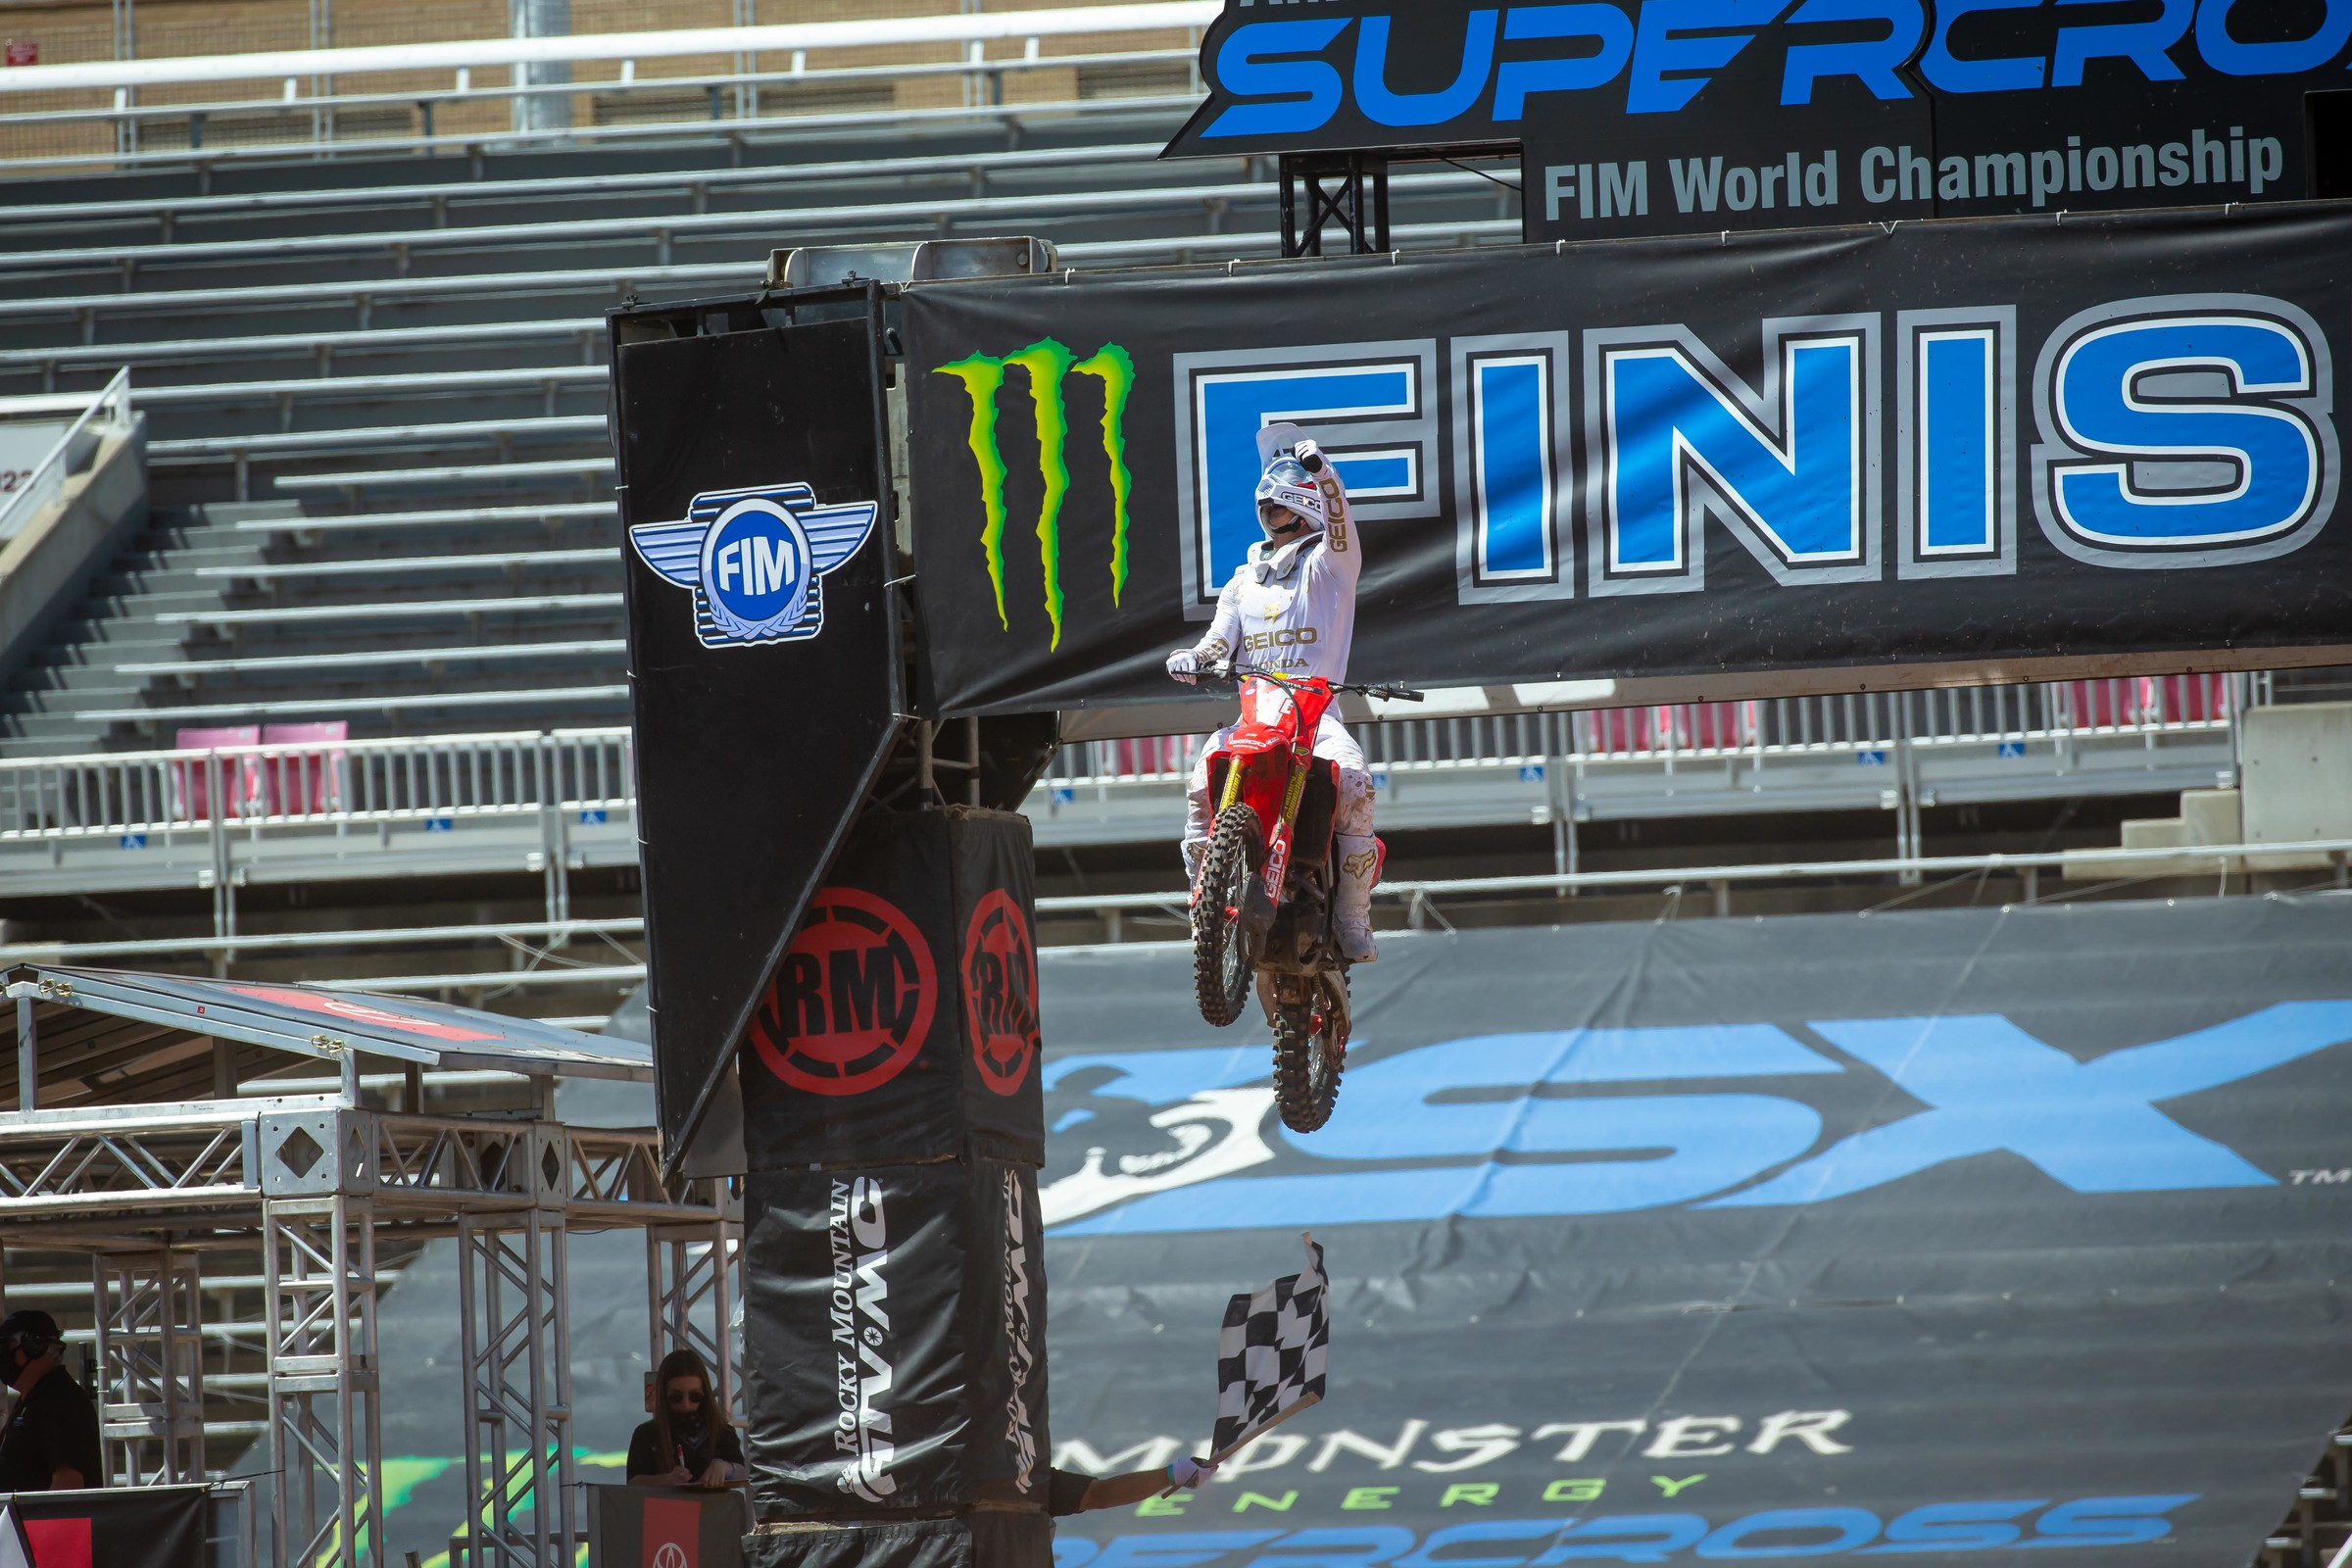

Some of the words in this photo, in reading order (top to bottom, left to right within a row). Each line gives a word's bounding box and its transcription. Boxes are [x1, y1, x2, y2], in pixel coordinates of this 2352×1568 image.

[1200, 0, 2352, 138] SUPERCRO
[1544, 161, 1648, 220] FIM
[1668, 150, 1838, 213] World
[1860, 125, 2283, 208] Championship
[1173, 292, 2341, 621] FINIS
[1318, 477, 1348, 552] GEICO
[718, 535, 796, 597] FIM
[1244, 627, 1318, 653] GEICO
[1264, 839, 1287, 899] GEICO
[777, 945, 898, 1039] RM
[830, 1178, 856, 1348] MOUNTAIN
[836, 1351, 858, 1455] ROCKY
[1134, 1473, 1709, 1517] ENERGY
